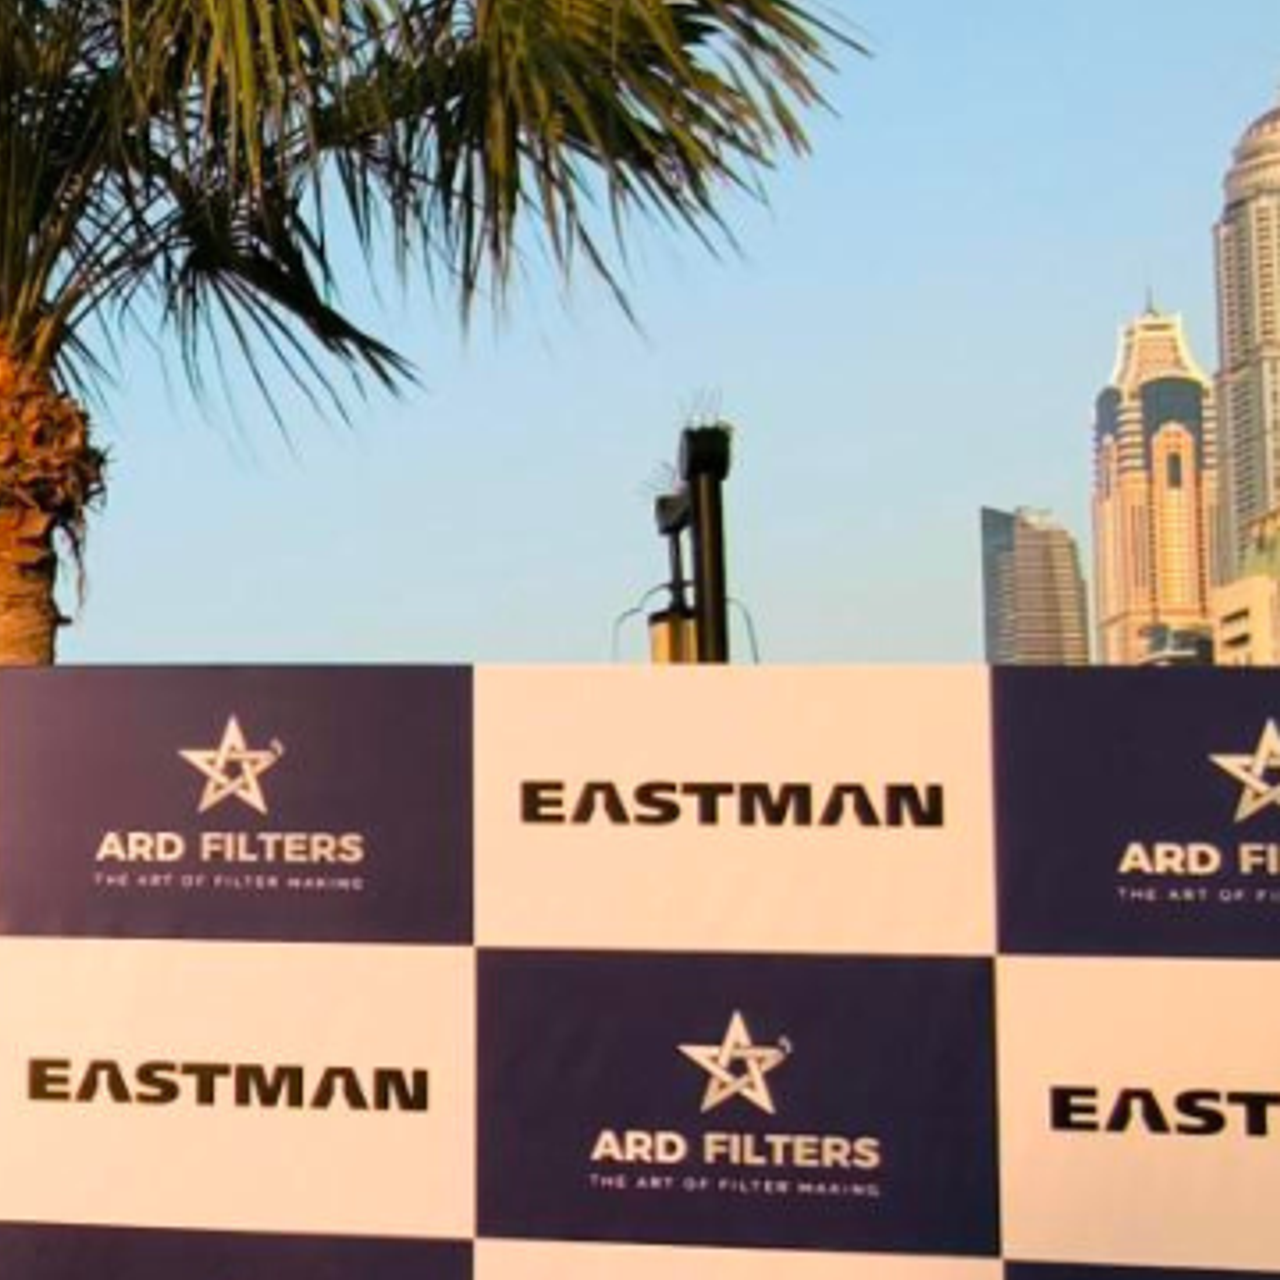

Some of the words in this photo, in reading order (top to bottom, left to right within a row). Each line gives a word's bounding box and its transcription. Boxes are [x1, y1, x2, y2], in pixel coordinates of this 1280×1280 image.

[522, 782, 943, 827] EASTMAN
[96, 832, 186, 861] ARD
[200, 831, 364, 863] FILTERS
[1118, 841, 1221, 874] ARD
[29, 1059, 428, 1111] EASTMAN
[590, 1130, 687, 1163] ARD
[704, 1133, 881, 1169] FILTERS
